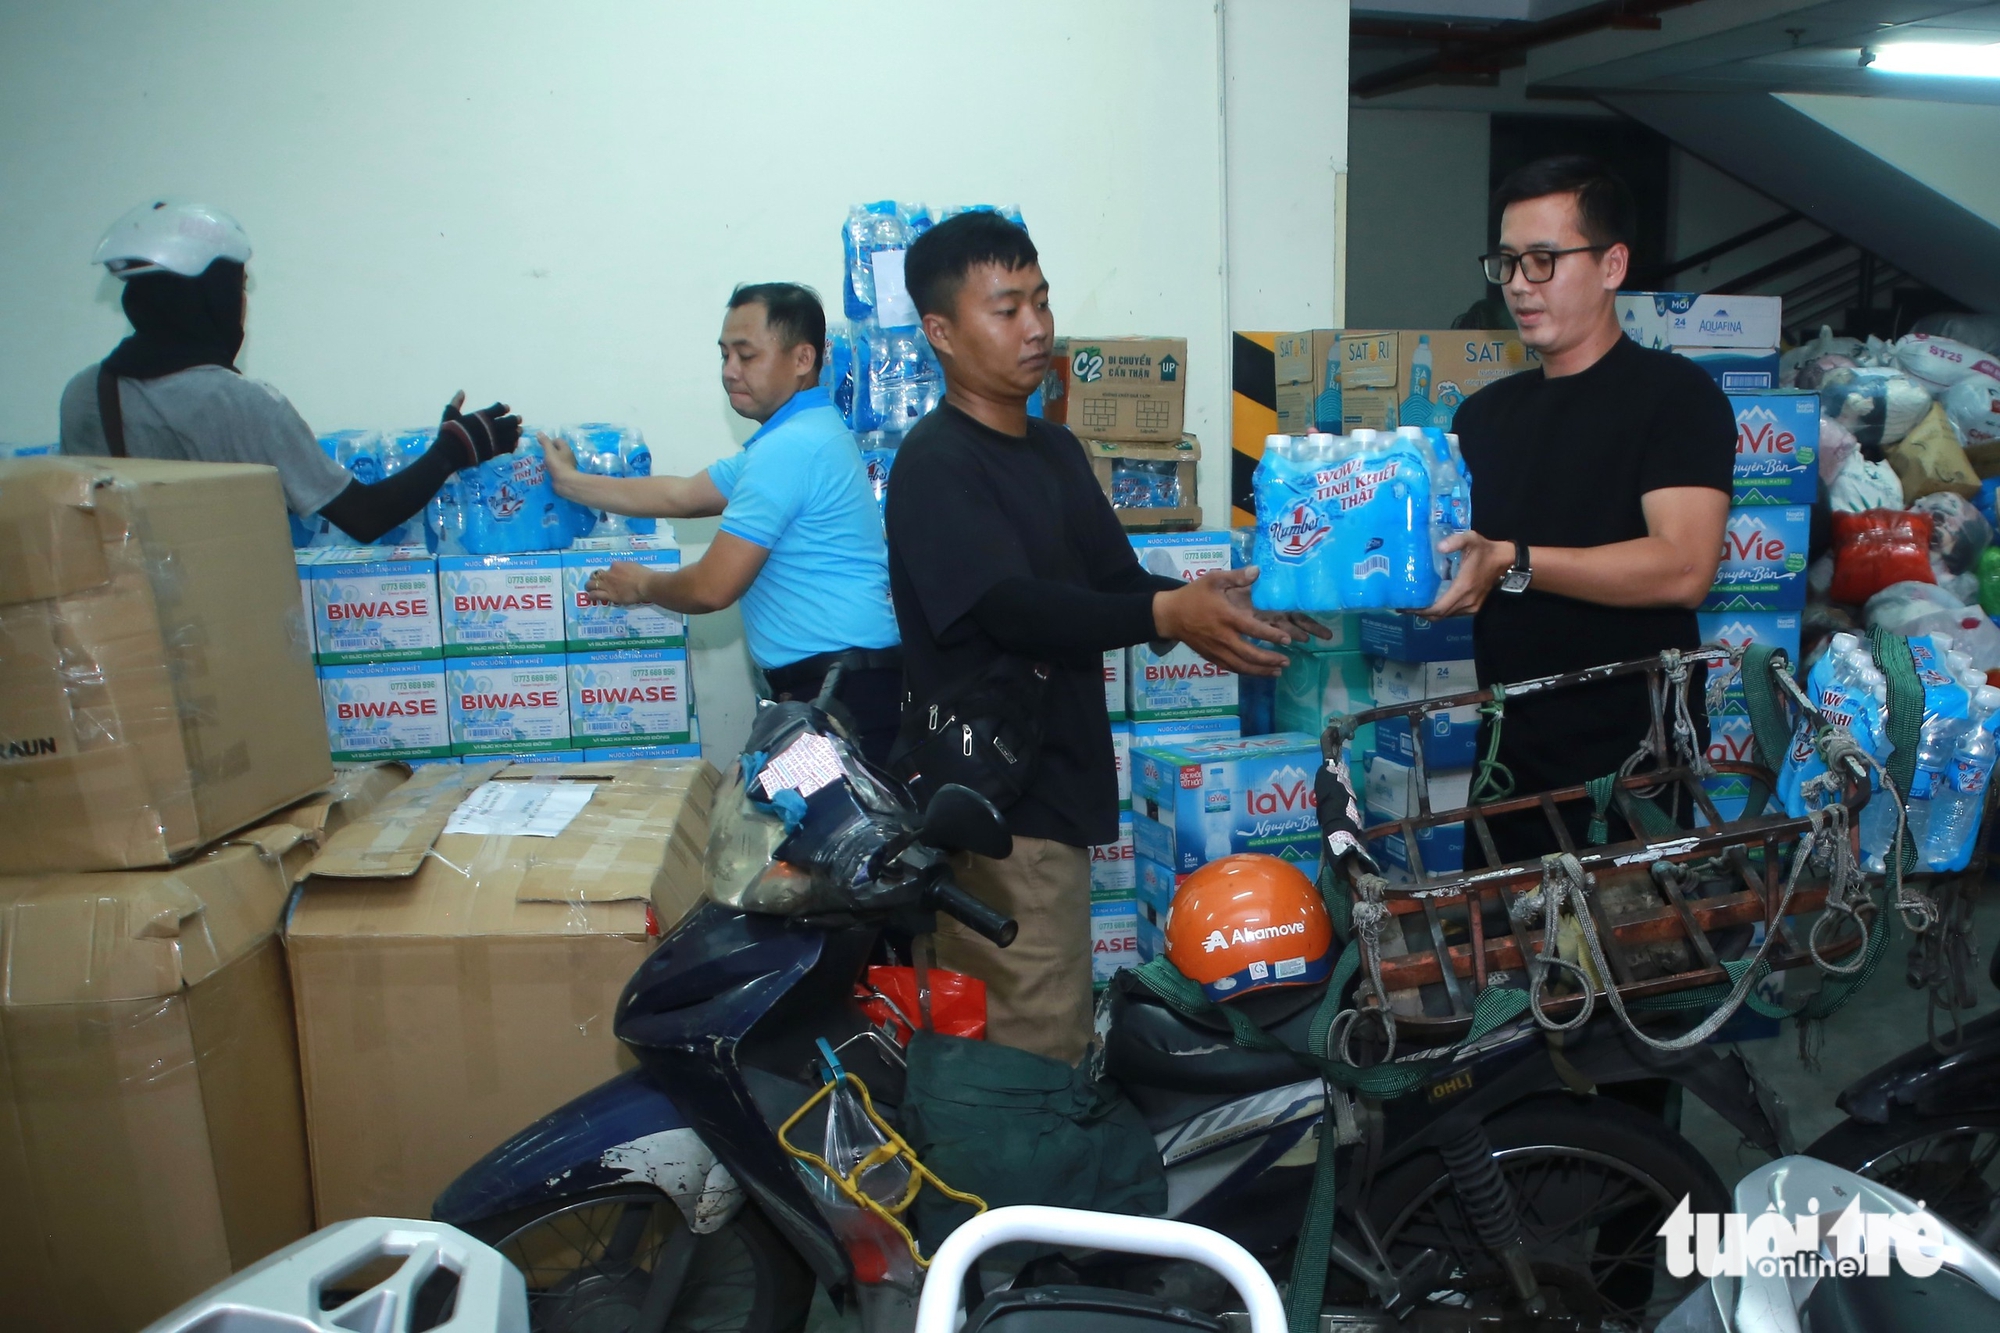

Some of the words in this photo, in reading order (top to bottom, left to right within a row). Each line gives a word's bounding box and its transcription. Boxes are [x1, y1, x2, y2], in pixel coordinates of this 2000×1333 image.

[1674, 318, 1686, 326] 24
[1698, 319, 1743, 335] AQUAFINA
[1118, 353, 1151, 366] CHUYỂN
[1929, 345, 1963, 363] ST25
[1073, 351, 1103, 382] C2
[1162, 362, 1176, 373] UP
[1316, 459, 1363, 485] WOW!
[1316, 482, 1350, 501] TINH
[1355, 462, 1400, 489] KHIẾT
[1341, 487, 1376, 511] THẬT
[1270, 513, 1325, 543] Number
[1720, 530, 1786, 561] aVie
[327, 599, 428, 620] BIWASE
[454, 594, 552, 612] BIWASE
[1437, 667, 1450, 676] 24
[461, 691, 558, 710] BIWASE
[581, 685, 676, 704] BIWASE
[337, 698, 437, 719] BIWASE
[1236, 819, 1300, 838] Nguyên
[1232, 920, 1305, 945] Ahamove
[1091, 937, 1137, 953] ASE
